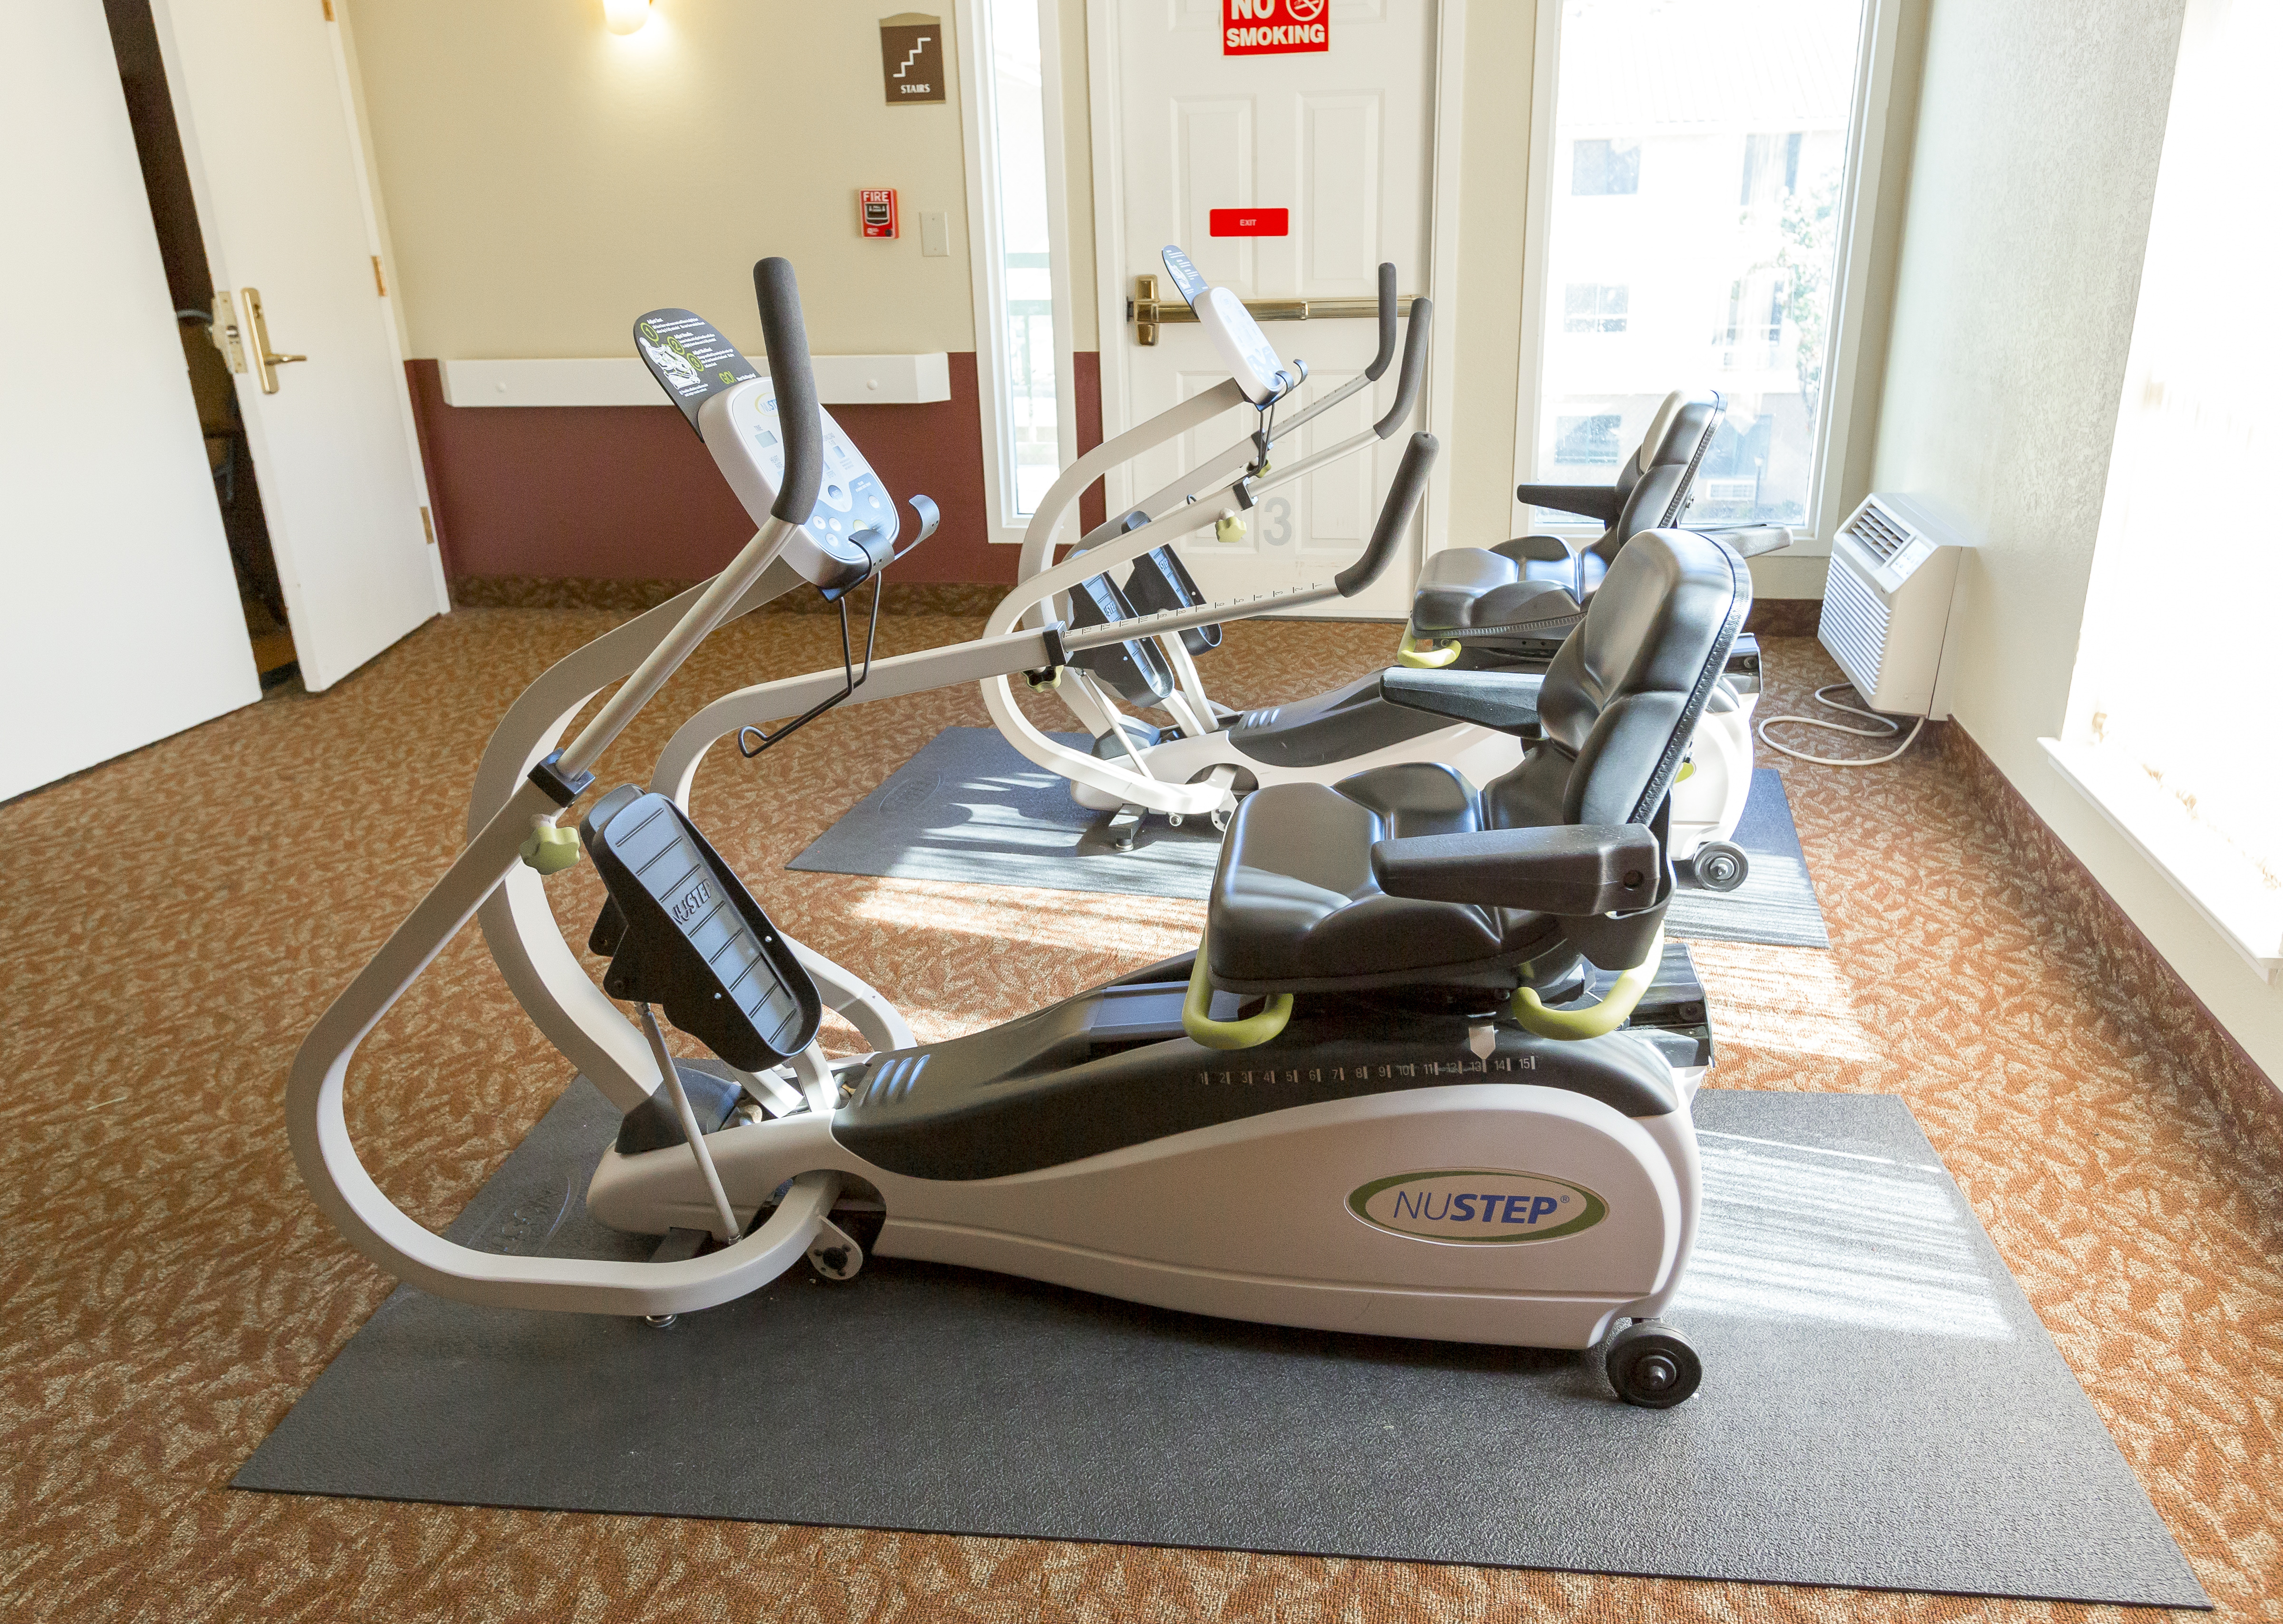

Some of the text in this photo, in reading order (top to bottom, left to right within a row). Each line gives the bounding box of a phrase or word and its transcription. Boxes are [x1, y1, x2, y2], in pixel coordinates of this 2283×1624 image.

[1231, 0, 1275, 20] NO
[1226, 24, 1325, 47] SMOKING
[900, 84, 931, 94] STAIRS
[863, 192, 889, 202] FIRE
[645, 327, 654, 337] 1
[671, 340, 681, 350] 2
[691, 357, 701, 368] 3
[719, 371, 737, 384] GO!
[760, 399, 778, 413] NUST
[1263, 497, 1292, 546] 3
[1200, 1073, 1204, 1084] 1
[1220, 1073, 1226, 1083] 2
[1242, 1072, 1247, 1083] 3
[1263, 1071, 1270, 1082] 4
[1286, 1071, 1293, 1082] 5
[1309, 1070, 1316, 1081] 6
[1332, 1069, 1338, 1079] 7
[1356, 1067, 1362, 1078] 8
[1378, 1066, 1386, 1077] 9
[1399, 1065, 1409, 1076] 10
[1424, 1064, 1433, 1075] 11
[1470, 1061, 1481, 1072] 13
[1494, 1060, 1504, 1070] 14
[1519, 1058, 1530, 1069] 15
